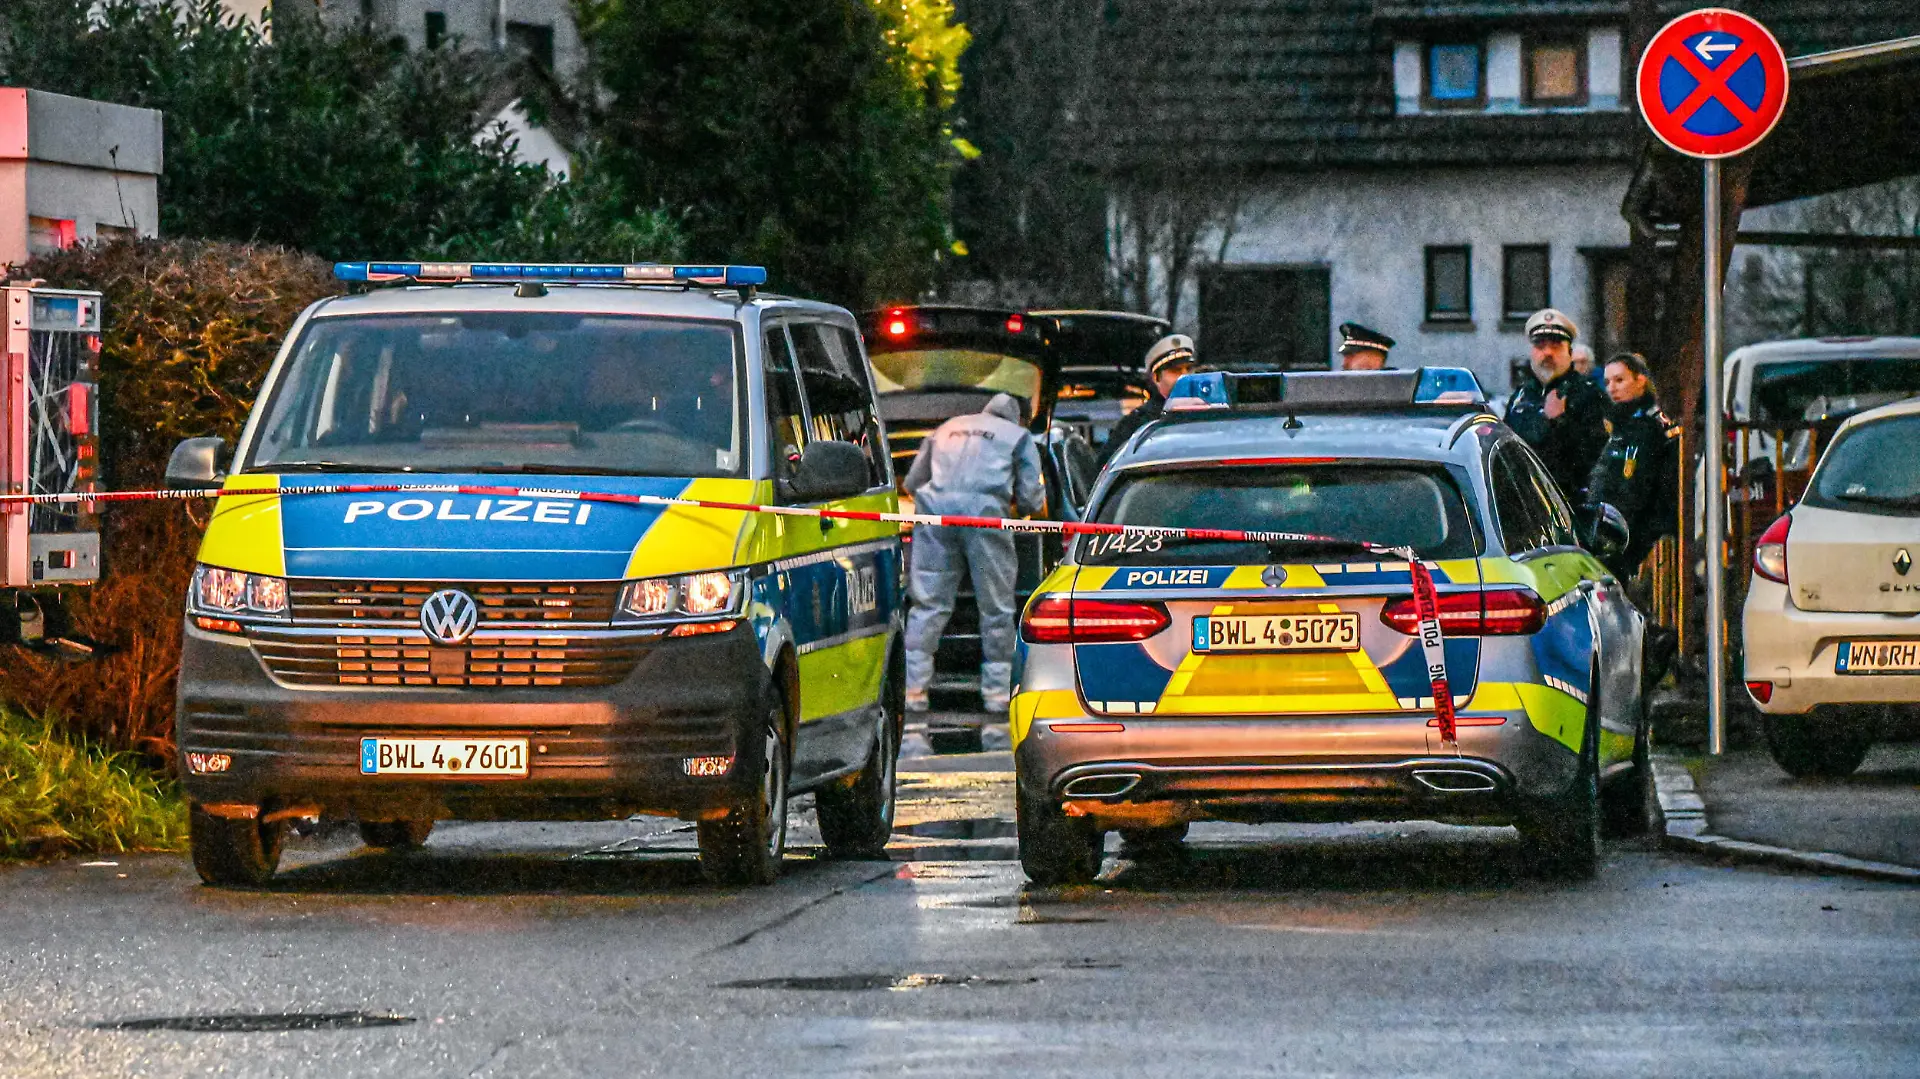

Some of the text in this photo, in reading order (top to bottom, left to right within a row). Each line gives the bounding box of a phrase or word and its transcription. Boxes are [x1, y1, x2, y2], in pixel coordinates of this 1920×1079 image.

[343, 499, 592, 525] POLIZEI
[1087, 532, 1164, 556] 1/423
[1127, 569, 1209, 586] POLIZEI
[1210, 620, 1256, 645] BWL
[1263, 619, 1276, 644] 4
[1295, 618, 1354, 643] 5075
[1851, 645, 1877, 666] WN
[1889, 645, 1917, 666] RH
[379, 744, 425, 769] BWL
[432, 744, 445, 769] 4
[465, 744, 523, 769] 7601
